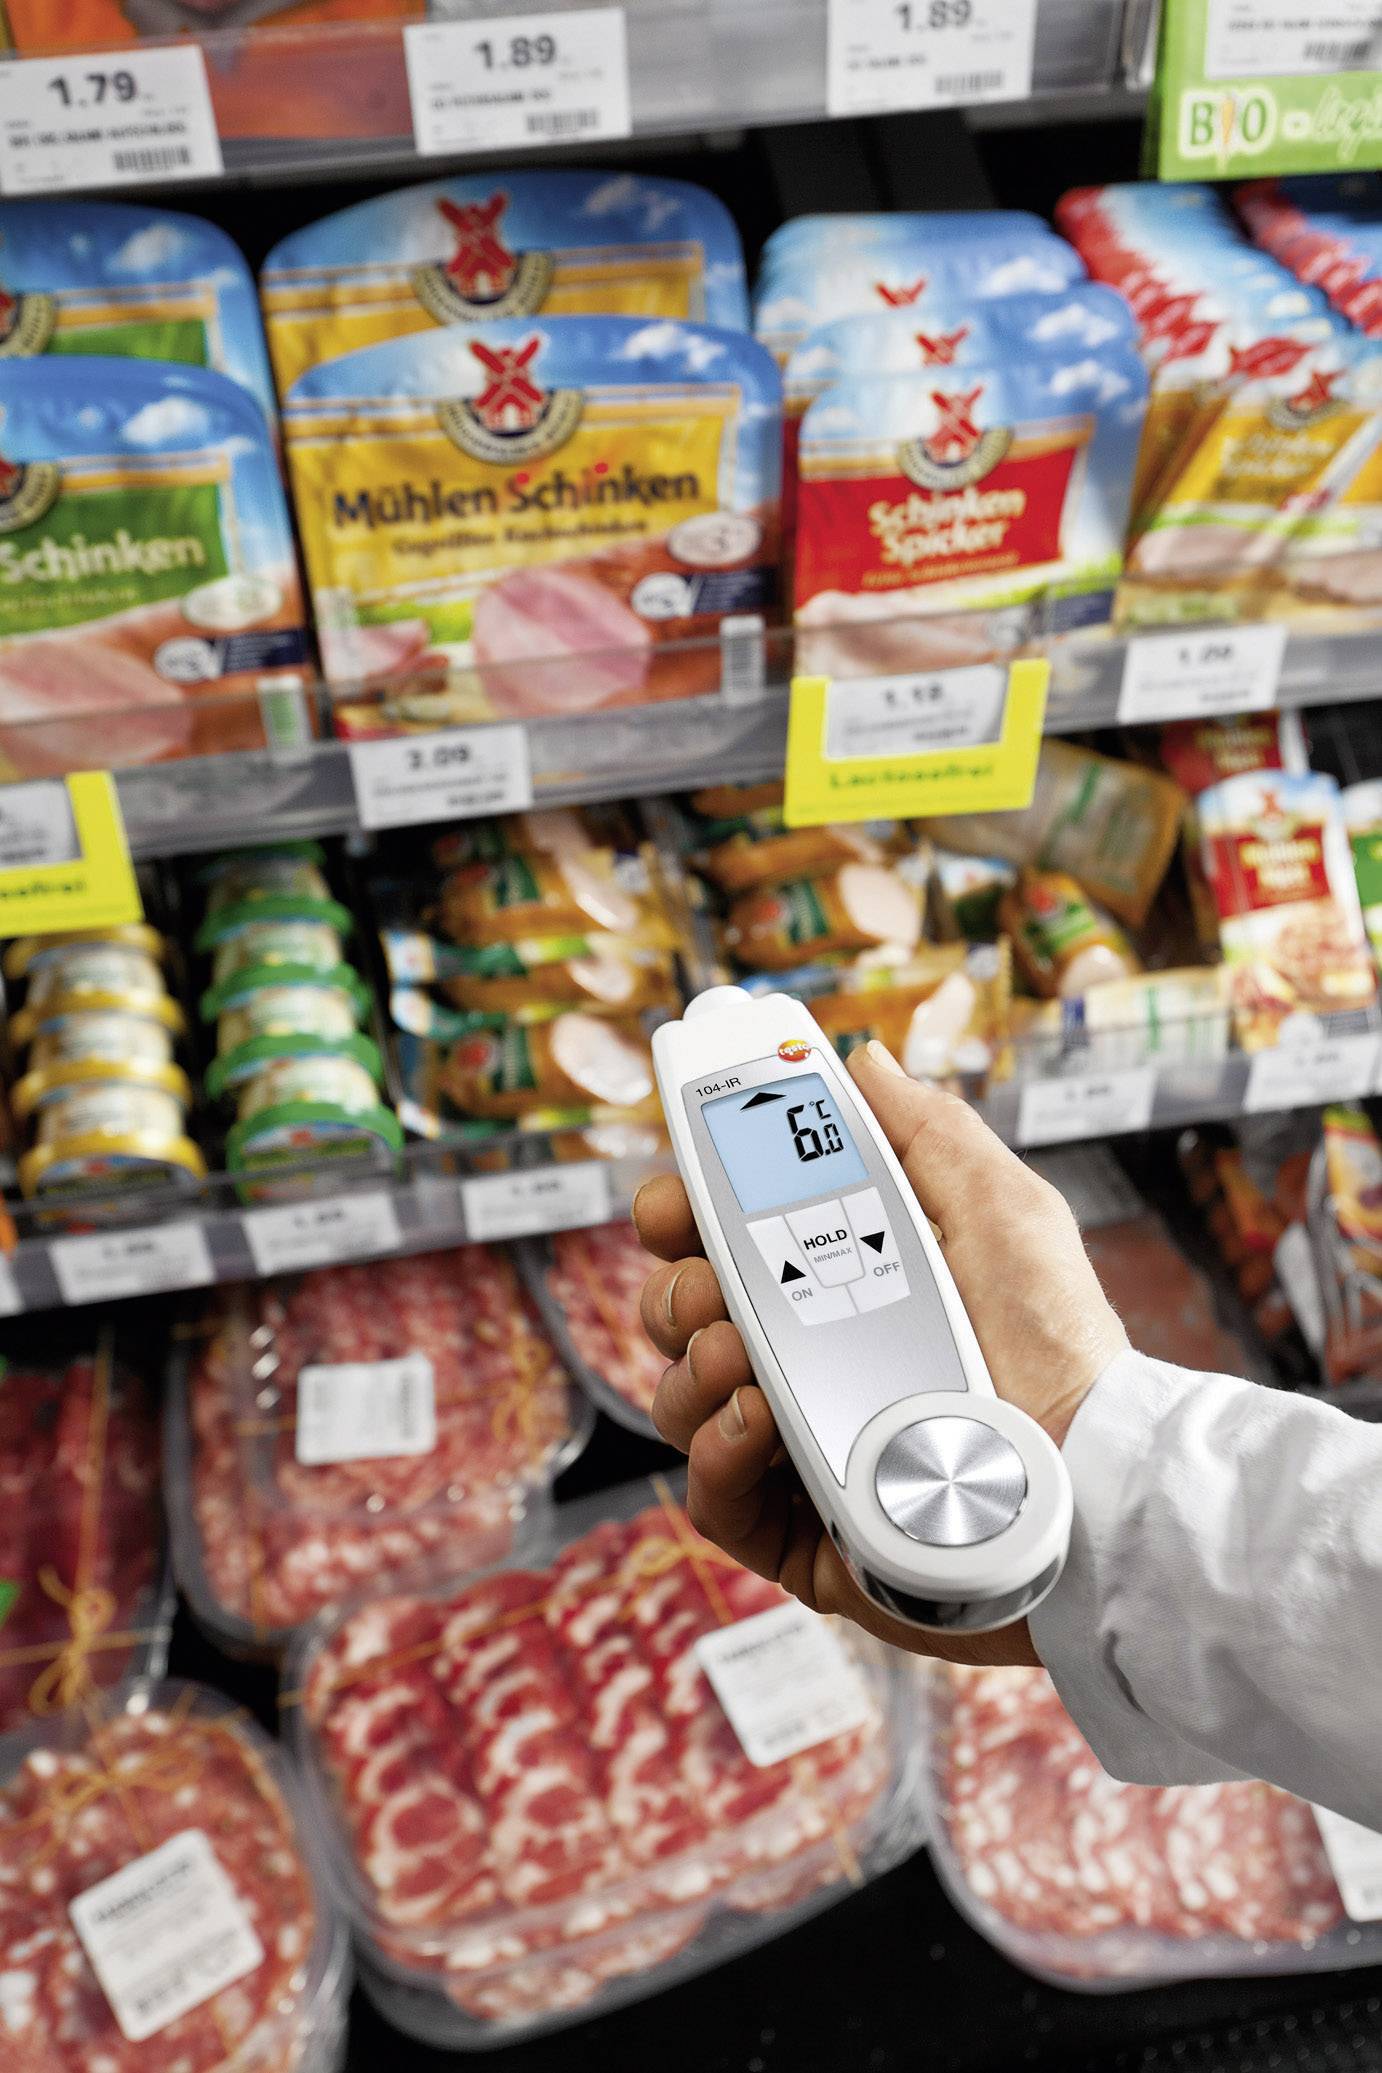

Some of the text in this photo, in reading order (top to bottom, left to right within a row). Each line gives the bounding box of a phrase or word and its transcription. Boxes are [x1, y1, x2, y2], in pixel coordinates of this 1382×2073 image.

[474, 34, 557, 70] 1.89
[48, 70, 138, 107] 1.79
[335, 463, 701, 529] Mühlen Schinken
[868, 484, 1027, 538] Schinken
[695, 1077, 742, 1097] 104-IR
[787, 1099, 844, 1162] 6.0 °C
[803, 1229, 848, 1250] HOLD
[813, 1247, 853, 1263] MIN/MAX
[873, 1261, 901, 1277] OFF
[791, 1287, 814, 1302] ON
